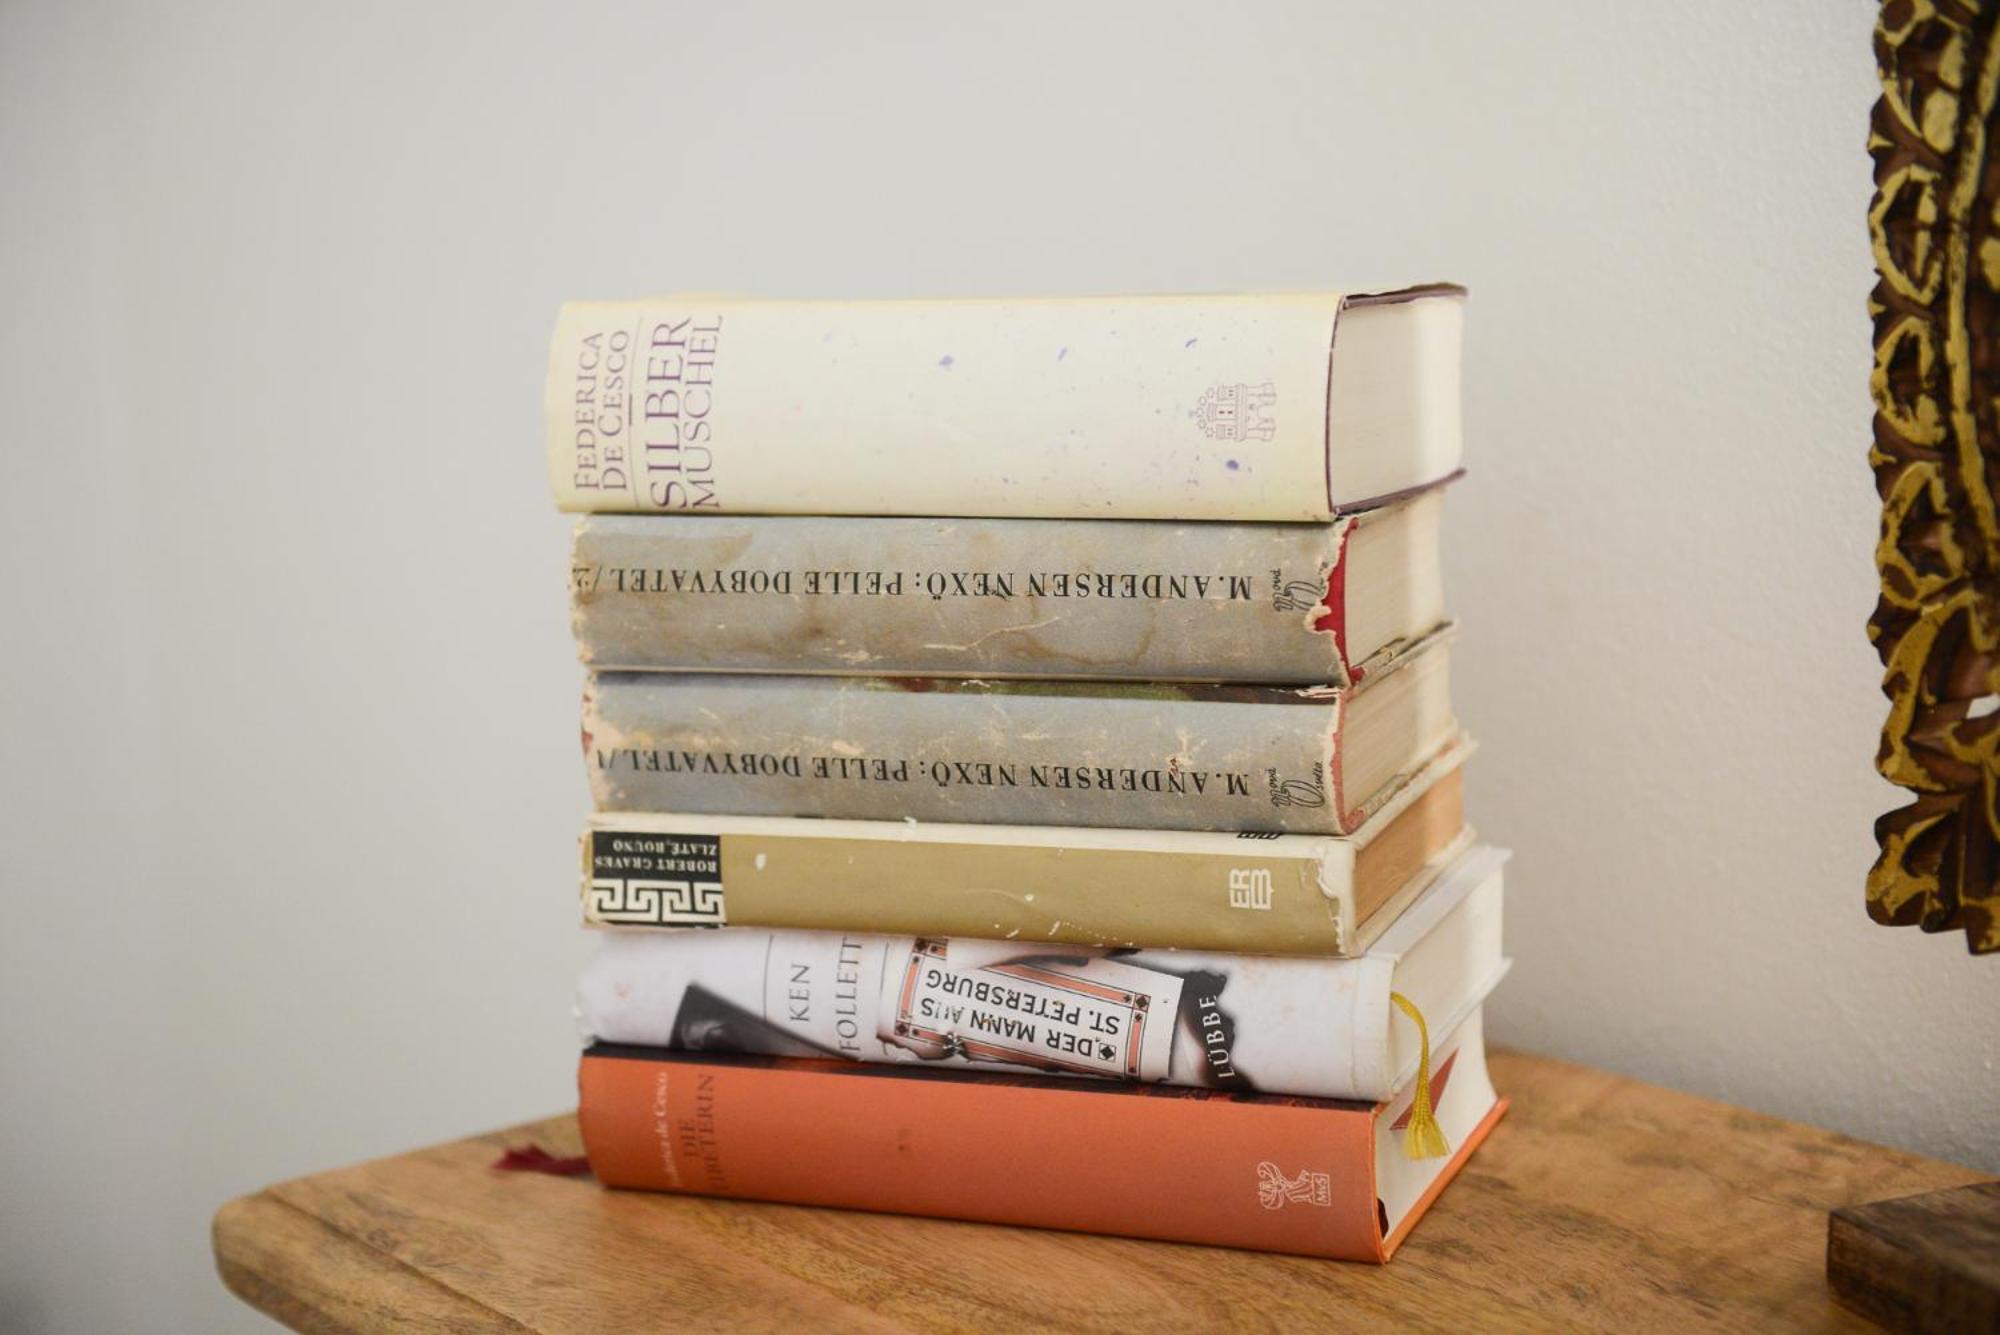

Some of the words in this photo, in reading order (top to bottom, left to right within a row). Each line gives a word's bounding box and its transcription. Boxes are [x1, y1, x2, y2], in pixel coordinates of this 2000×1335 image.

[598, 330, 630, 437] CESCO
[574, 332, 604, 490] FEDERICA
[645, 316, 692, 509] SILBER
[683, 315, 723, 509] MUSCHEL
[601, 446, 628, 491] DE
[804, 570, 904, 596] PELLE
[812, 756, 909, 782] PELLE
[594, 855, 652, 870] GRAVES
[612, 839, 666, 855] ROUNO
[657, 857, 718, 873] ROBERT
[788, 963, 811, 1022] KEN
[836, 936, 863, 1052] FOLLETT
[925, 969, 1082, 1019] PETERSBURG
[969, 1009, 1036, 1043] MANN
[1046, 1030, 1094, 1057] DER
[1089, 1010, 1121, 1036] ST.
[1199, 994, 1236, 1078] LÜBBE
[679, 1119, 699, 1157] DIE
